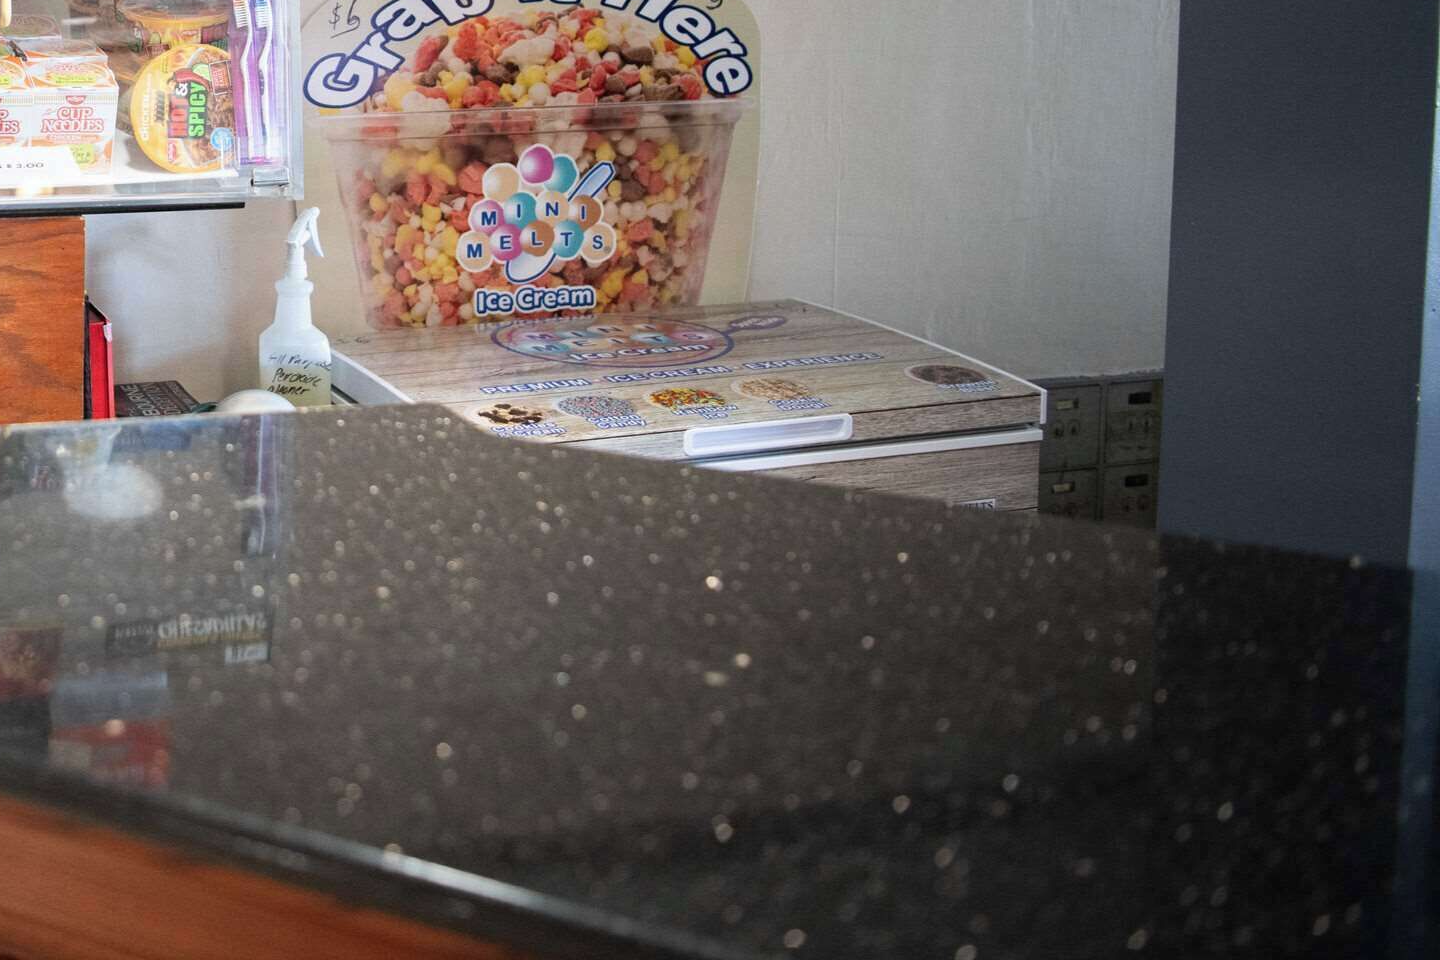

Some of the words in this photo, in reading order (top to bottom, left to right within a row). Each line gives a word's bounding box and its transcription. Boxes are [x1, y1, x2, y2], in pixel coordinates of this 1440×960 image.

[176, 82, 189, 97] &
[57, 106, 94, 120] CUP
[170, 95, 188, 138] HOT
[188, 82, 206, 138] SPICY
[41, 118, 104, 134] NOODLES
[481, 202, 586, 226] MINI
[466, 231, 604, 258] MELTS
[475, 289, 514, 314] Ice
[515, 286, 595, 311] Cream
[527, 323, 659, 341] MINI
[567, 350, 612, 362] Ice
[616, 343, 711, 358] Cream
[480, 377, 592, 396] PREMIUM
[605, 372, 647, 384] ICE
[647, 365, 733, 381] CREAM
[744, 351, 885, 370] EXPERIENCE
[671, 404, 739, 416] Rainbow
[703, 410, 729, 420] Ice
[586, 413, 646, 425] Cotton
[595, 417, 647, 430] Candy
[490, 421, 559, 435] Cookies
